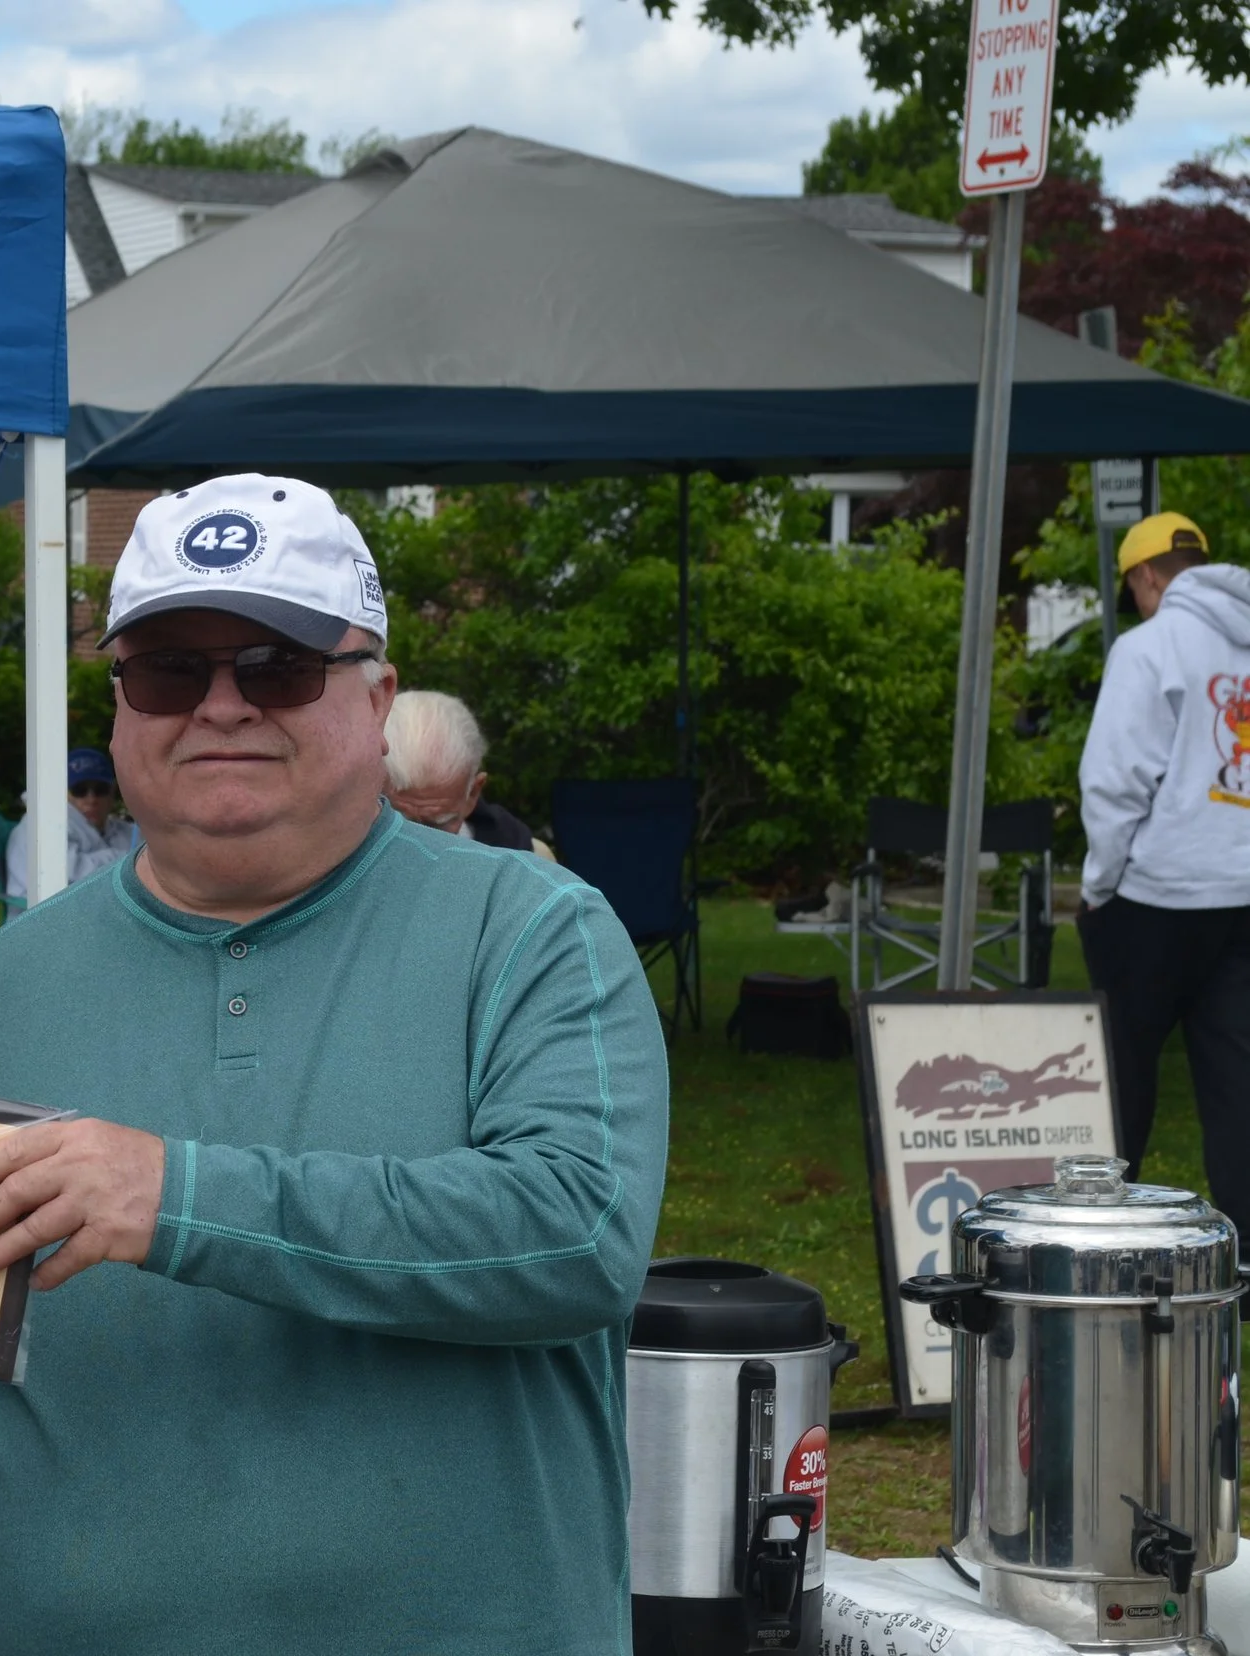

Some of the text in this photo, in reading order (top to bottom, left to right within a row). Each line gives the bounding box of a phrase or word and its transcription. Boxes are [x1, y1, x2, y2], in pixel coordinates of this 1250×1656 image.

[977, 19, 1049, 61] STOPPING
[991, 65, 1026, 99] ANY
[989, 106, 1024, 139] TIME
[1100, 476, 1142, 491] REQUIR
[191, 525, 248, 551] 42
[188, 565, 210, 575] LIME
[220, 564, 242, 575] 2024
[900, 1125, 1095, 1150] LONG ISLAND CHAPTER
[763, 1406, 774, 1416] 45
[762, 1450, 772, 1460] 35
[800, 1448, 826, 1476] 30%
[789, 1479, 813, 1493] Faster
[757, 1629, 791, 1639] PRESS CUP
[764, 1638, 782, 1647] HERE
